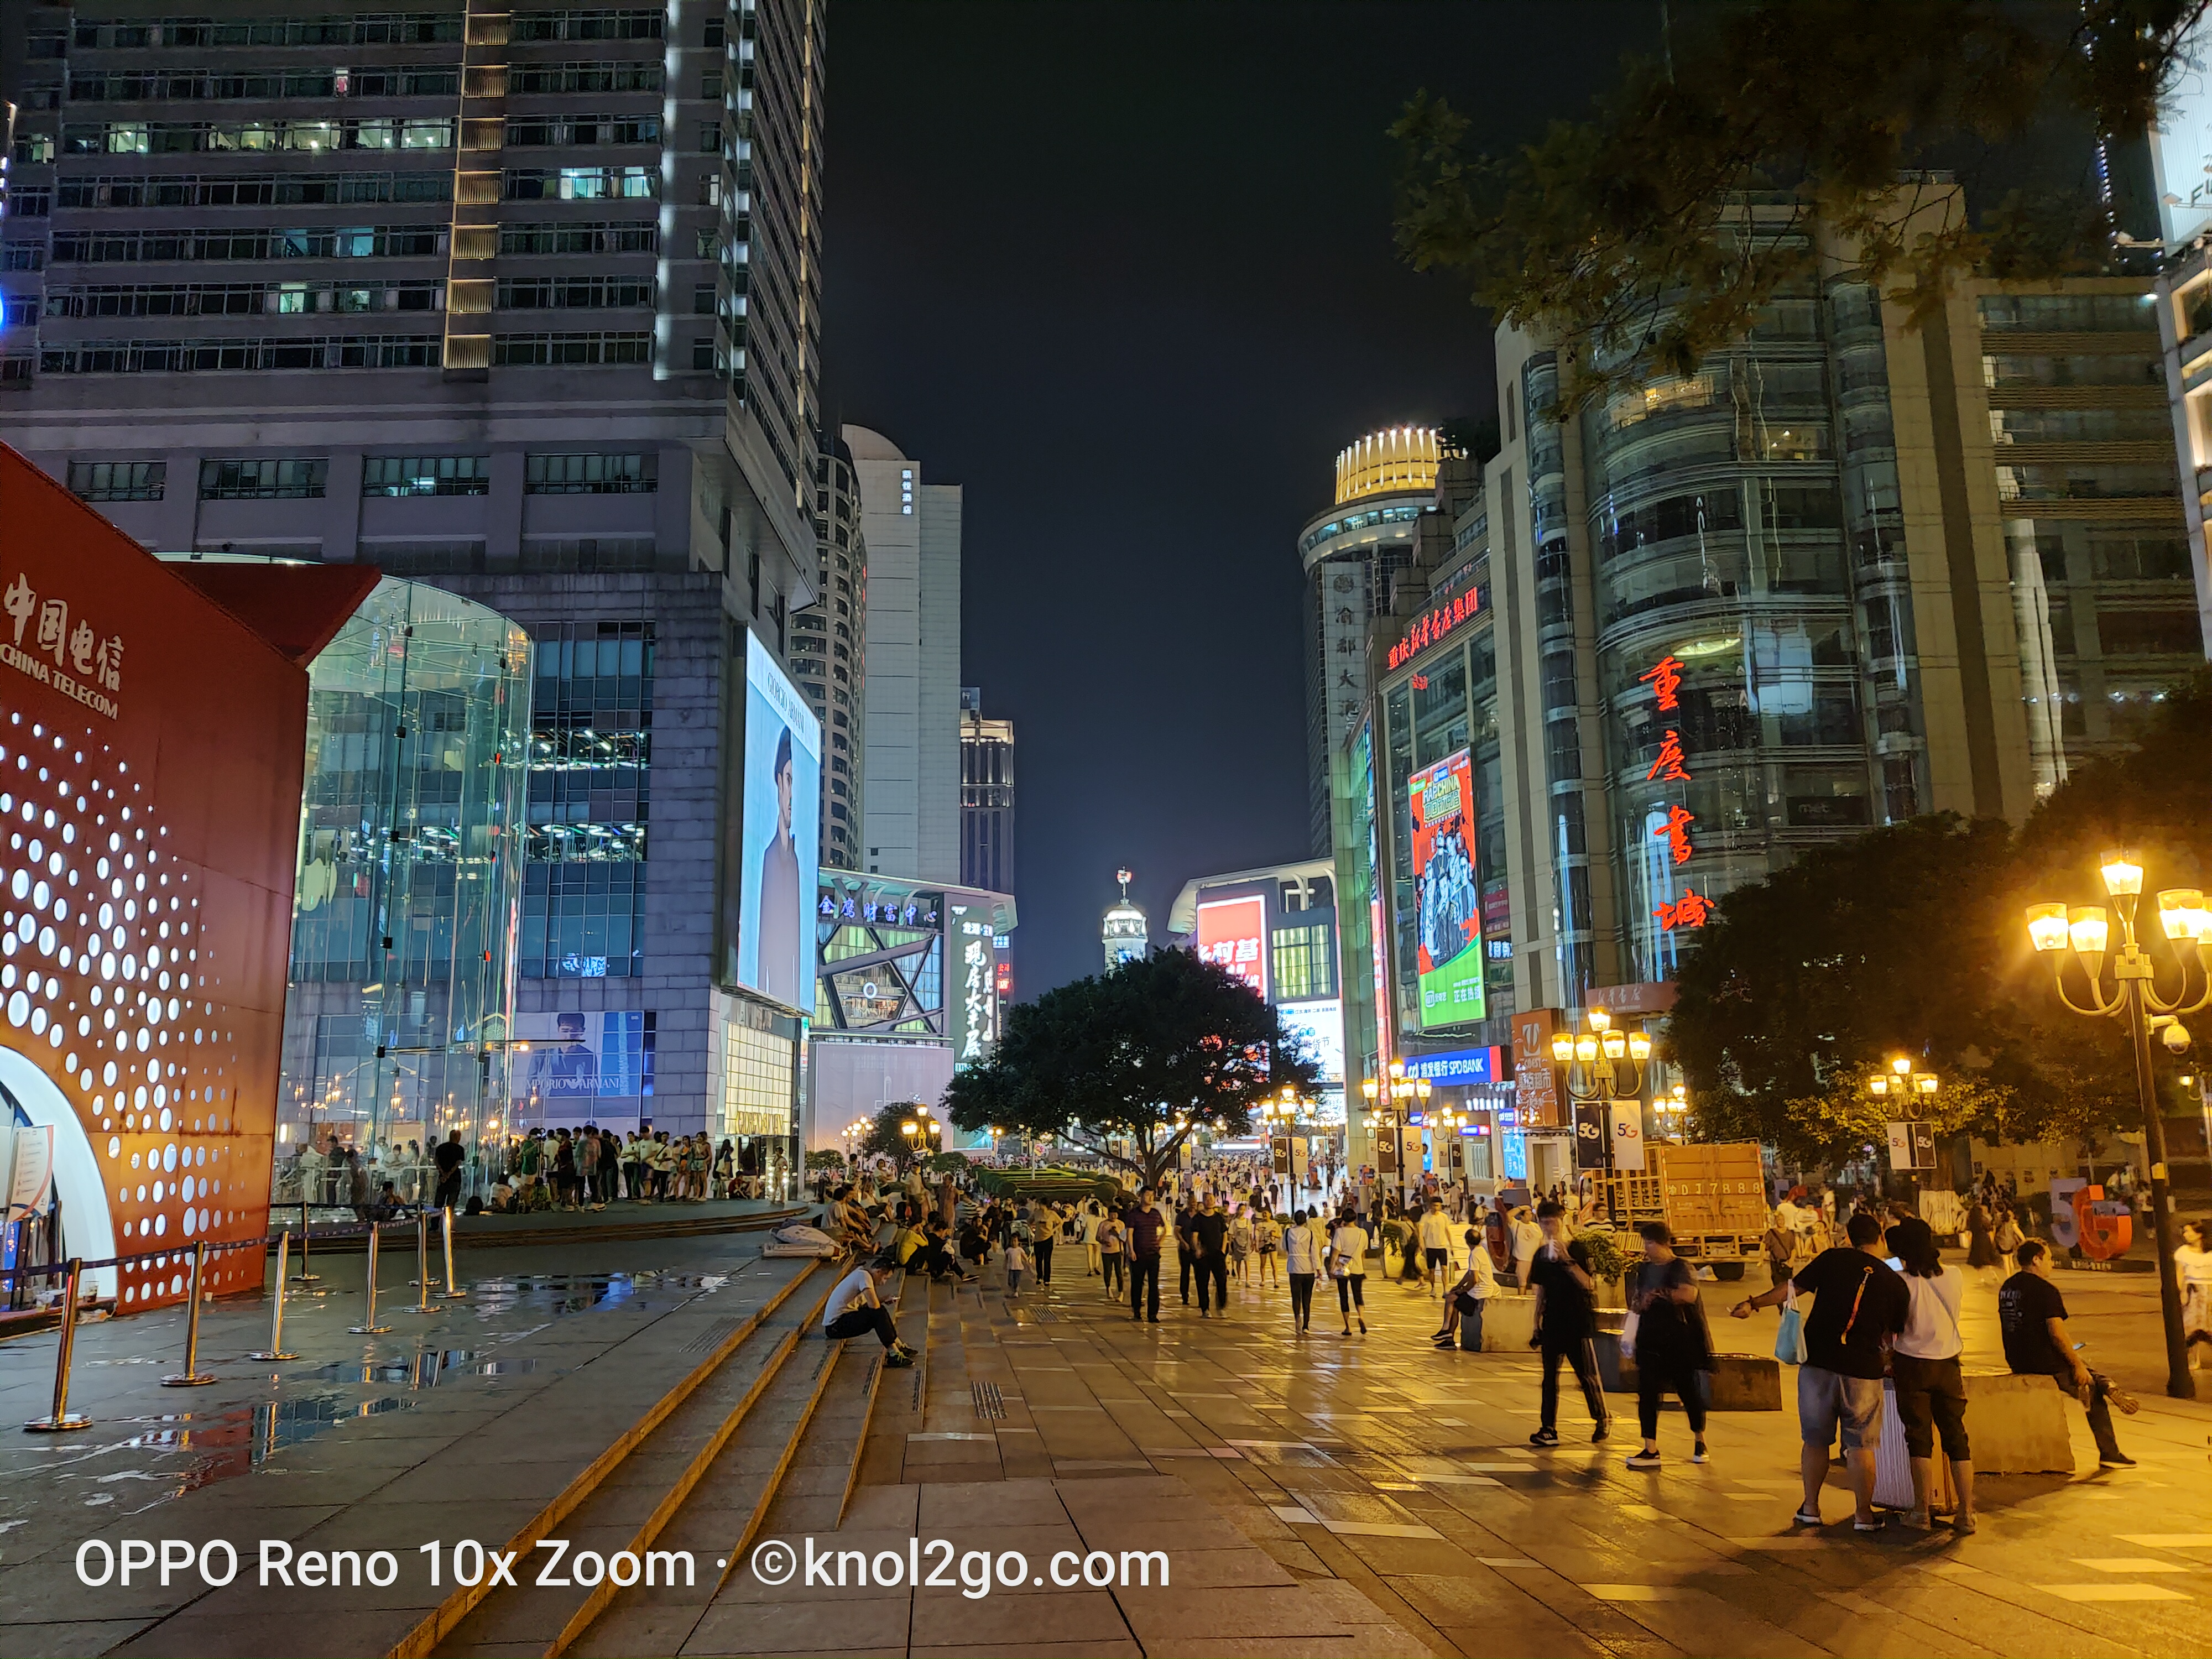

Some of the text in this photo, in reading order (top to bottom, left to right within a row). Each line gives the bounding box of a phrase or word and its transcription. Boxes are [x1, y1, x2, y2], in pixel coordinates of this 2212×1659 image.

[3, 572, 124, 692] 中国电信
[0, 643, 118, 720] CHINA TELECOM
[768, 672, 804, 734] GIORGIO ARMANI
[1423, 785, 1438, 803] RAP
[1437, 775, 1460, 797] CHINA
[819, 895, 937, 926] 金鹰财富中心
[1421, 1057, 1484, 1078] 浦发银行 SPD BANK
[581, 1078, 619, 1089] ARMANI
[1578, 1122, 1600, 1139] 5G
[1618, 1123, 1638, 1139] 5G
[1379, 1141, 1394, 1153] 5G
[1406, 1141, 1420, 1152] 5G
[1892, 1138, 1906, 1147] 5G
[1917, 1136, 1932, 1148] 5G
[1275, 1148, 1286, 1157] 5G
